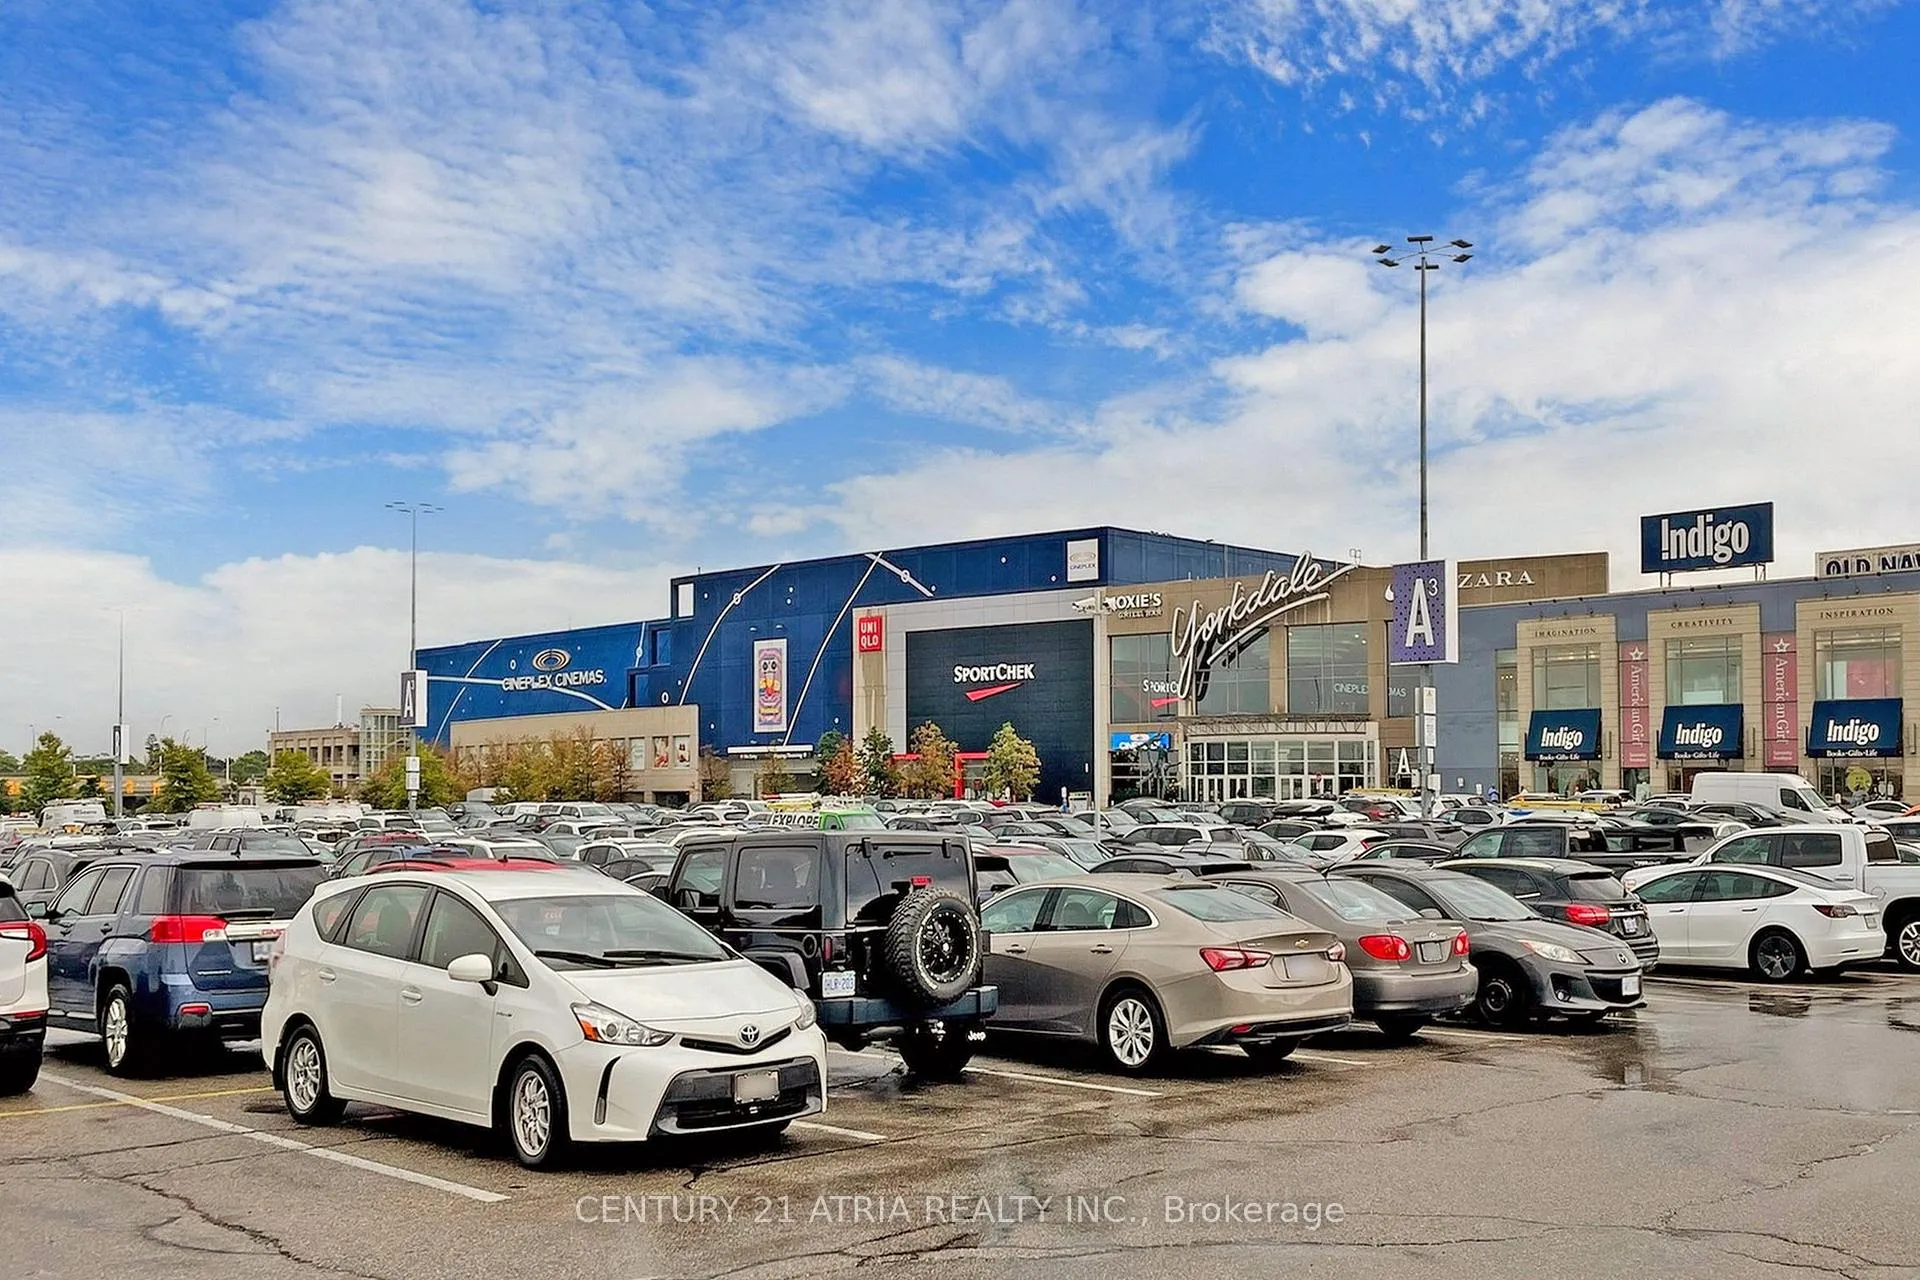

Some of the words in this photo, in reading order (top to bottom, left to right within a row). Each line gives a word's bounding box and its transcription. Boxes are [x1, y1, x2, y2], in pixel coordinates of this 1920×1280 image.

[1661, 513, 1750, 563] Indigo
[1457, 570, 1535, 588] ZARA
[1819, 606, 1895, 619] INSPIRATION
[860, 621, 877, 633] UNI
[1171, 551, 1359, 699] Yorkdale
[1670, 618, 1733, 629] CREATIVITY
[1534, 627, 1597, 638] IMAGINATION
[860, 634, 879, 649] QLO
[502, 675, 553, 691] CINEPLEX
[555, 669, 604, 687] CINEMAS
[953, 663, 1035, 683] SPORTCHEK
[1143, 679, 1179, 693] SPORTC
[1334, 682, 1369, 694] CINEPLE
[1541, 726, 1583, 750] Indigo
[1675, 722, 1722, 748] Indigo
[1826, 719, 1880, 745] Indigo
[967, 1030, 986, 1041] Jeep
